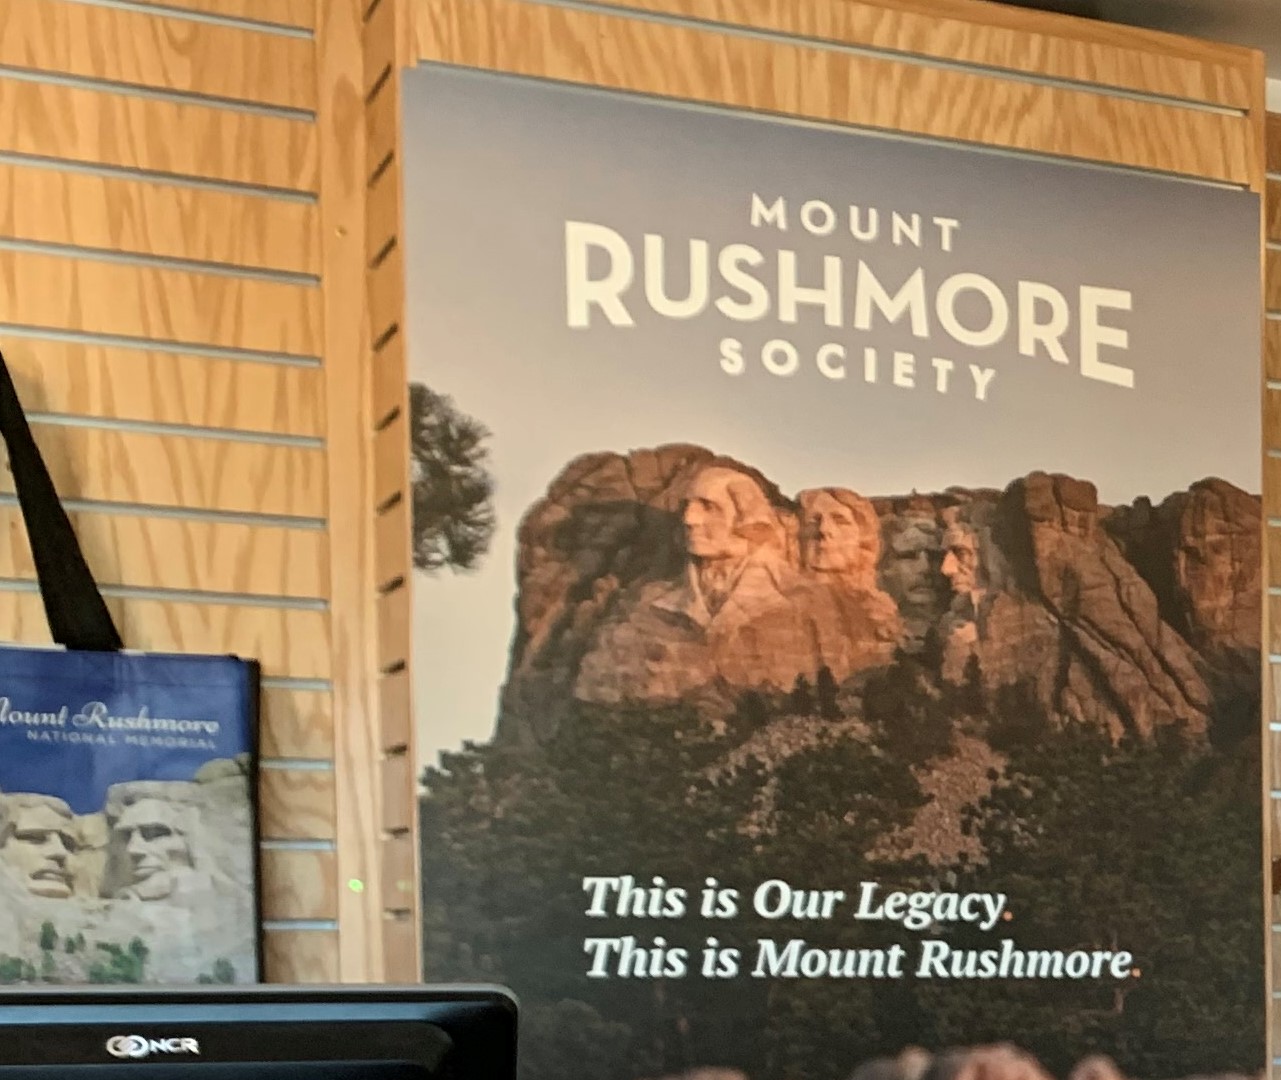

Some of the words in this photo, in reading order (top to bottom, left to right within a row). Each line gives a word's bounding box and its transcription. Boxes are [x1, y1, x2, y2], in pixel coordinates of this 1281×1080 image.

[751, 193, 960, 253] MOUNT
[563, 219, 1136, 389] RUSHMORE
[719, 337, 998, 401] SOCIETY
[26, 729, 117, 745] NATIONAL
[124, 735, 216, 750] MEMORIAL
[72, 701, 220, 734] Rushmore
[582, 874, 687, 921] This
[700, 875, 739, 920] is
[753, 878, 845, 921] Our
[854, 880, 1014, 931] Legacy.
[582, 936, 687, 979] This
[701, 936, 740, 979] is
[751, 939, 904, 980] Mount
[916, 940, 1141, 980] Rushmore.
[149, 1037, 200, 1056] NCR
